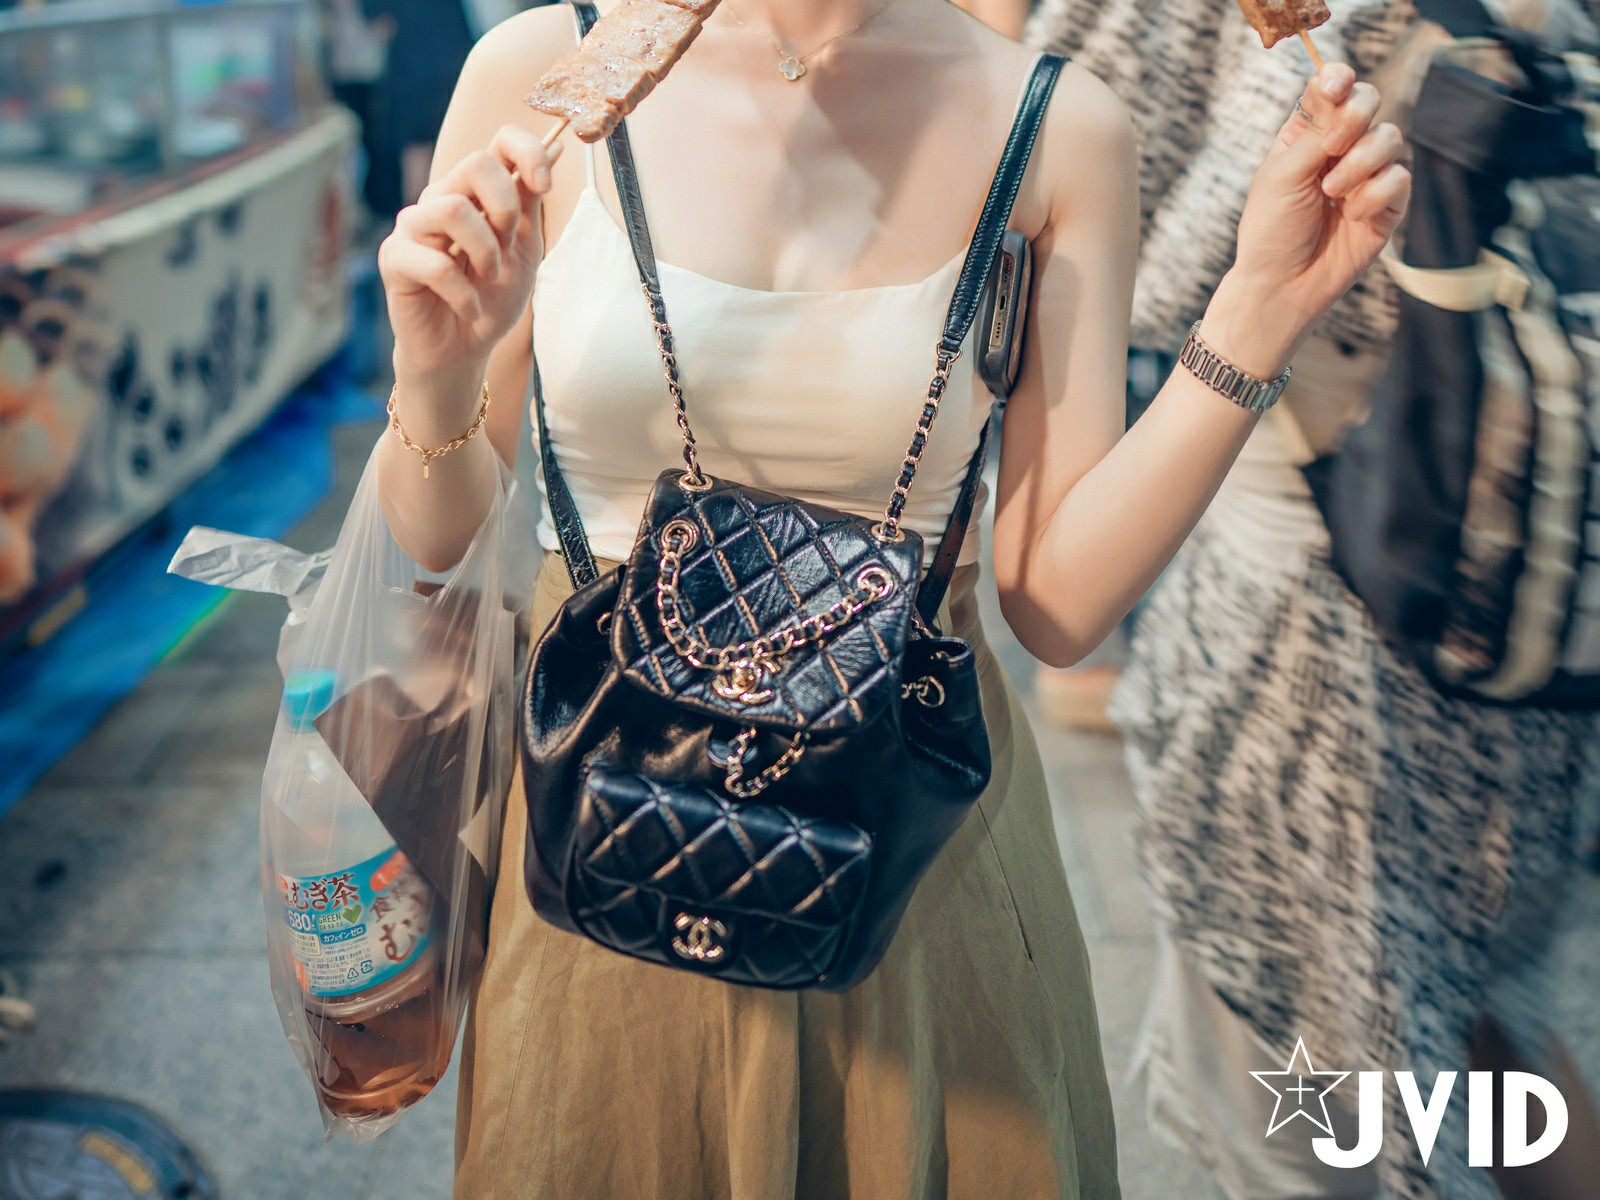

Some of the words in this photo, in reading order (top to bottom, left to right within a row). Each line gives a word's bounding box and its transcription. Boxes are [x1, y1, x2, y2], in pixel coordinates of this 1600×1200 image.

[291, 873, 359, 910] むぎ茶
[318, 912, 341, 924] GREEN
[323, 926, 364, 943] カフェインゼロ
